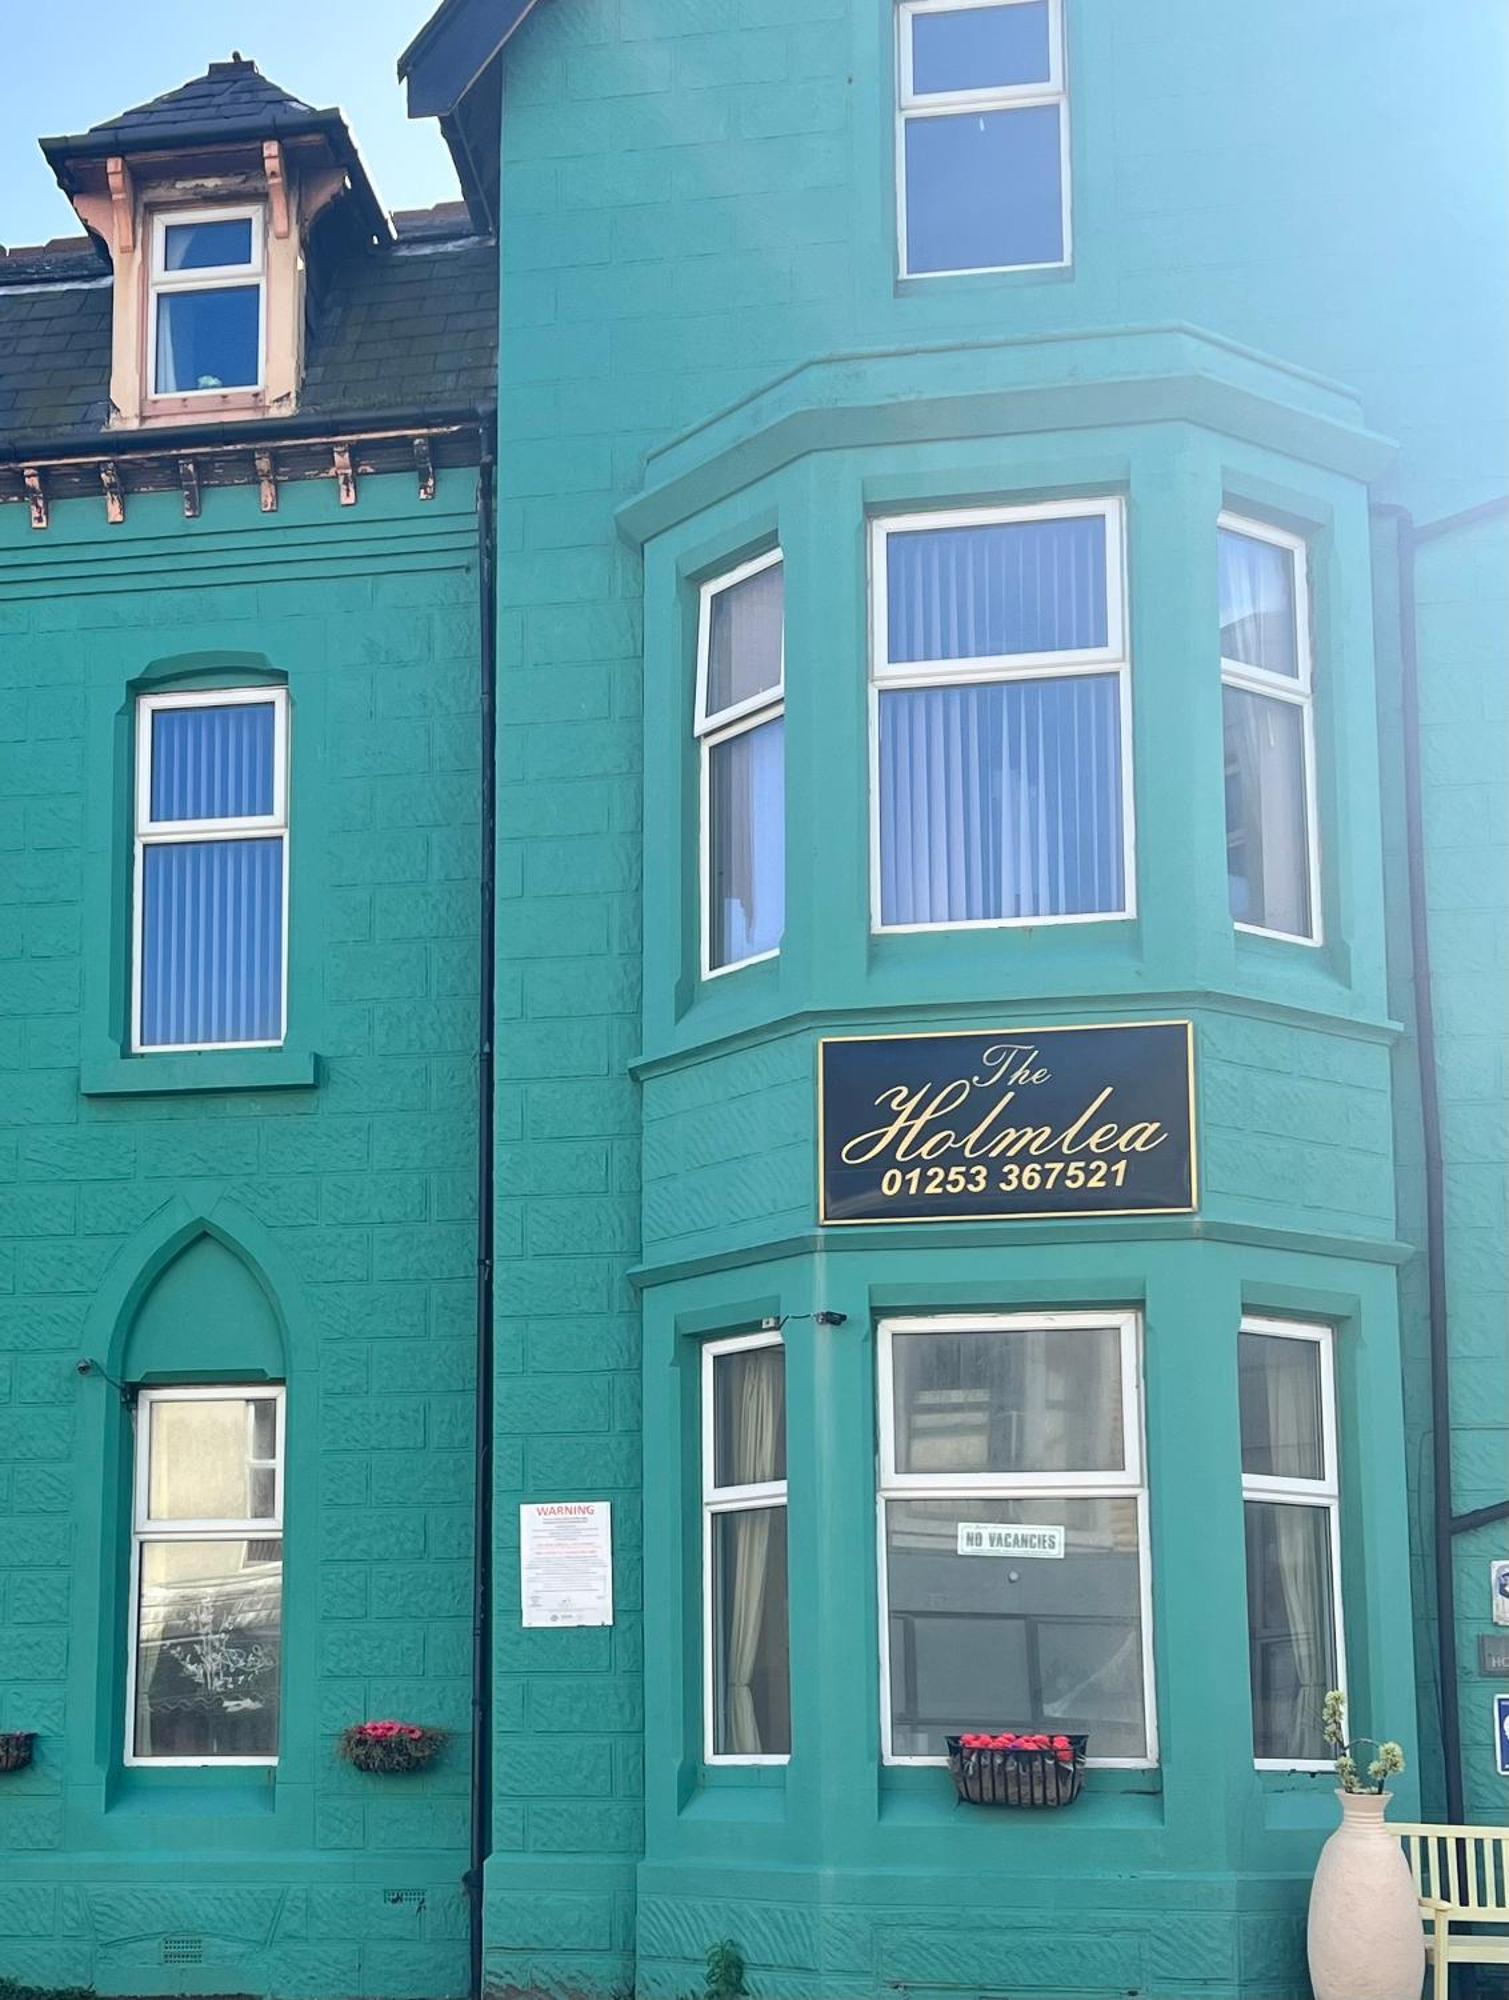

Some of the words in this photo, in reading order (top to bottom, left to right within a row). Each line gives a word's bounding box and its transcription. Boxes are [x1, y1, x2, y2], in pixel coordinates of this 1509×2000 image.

[972, 1044, 1053, 1088] The
[840, 1078, 1169, 1164] Holmlea
[881, 1164, 988, 1196] 01253
[999, 1159, 1128, 1192] 367521
[536, 1505, 595, 1516] WARNING
[966, 1531, 983, 1547] NO
[988, 1532, 1057, 1550] VACANCIES
